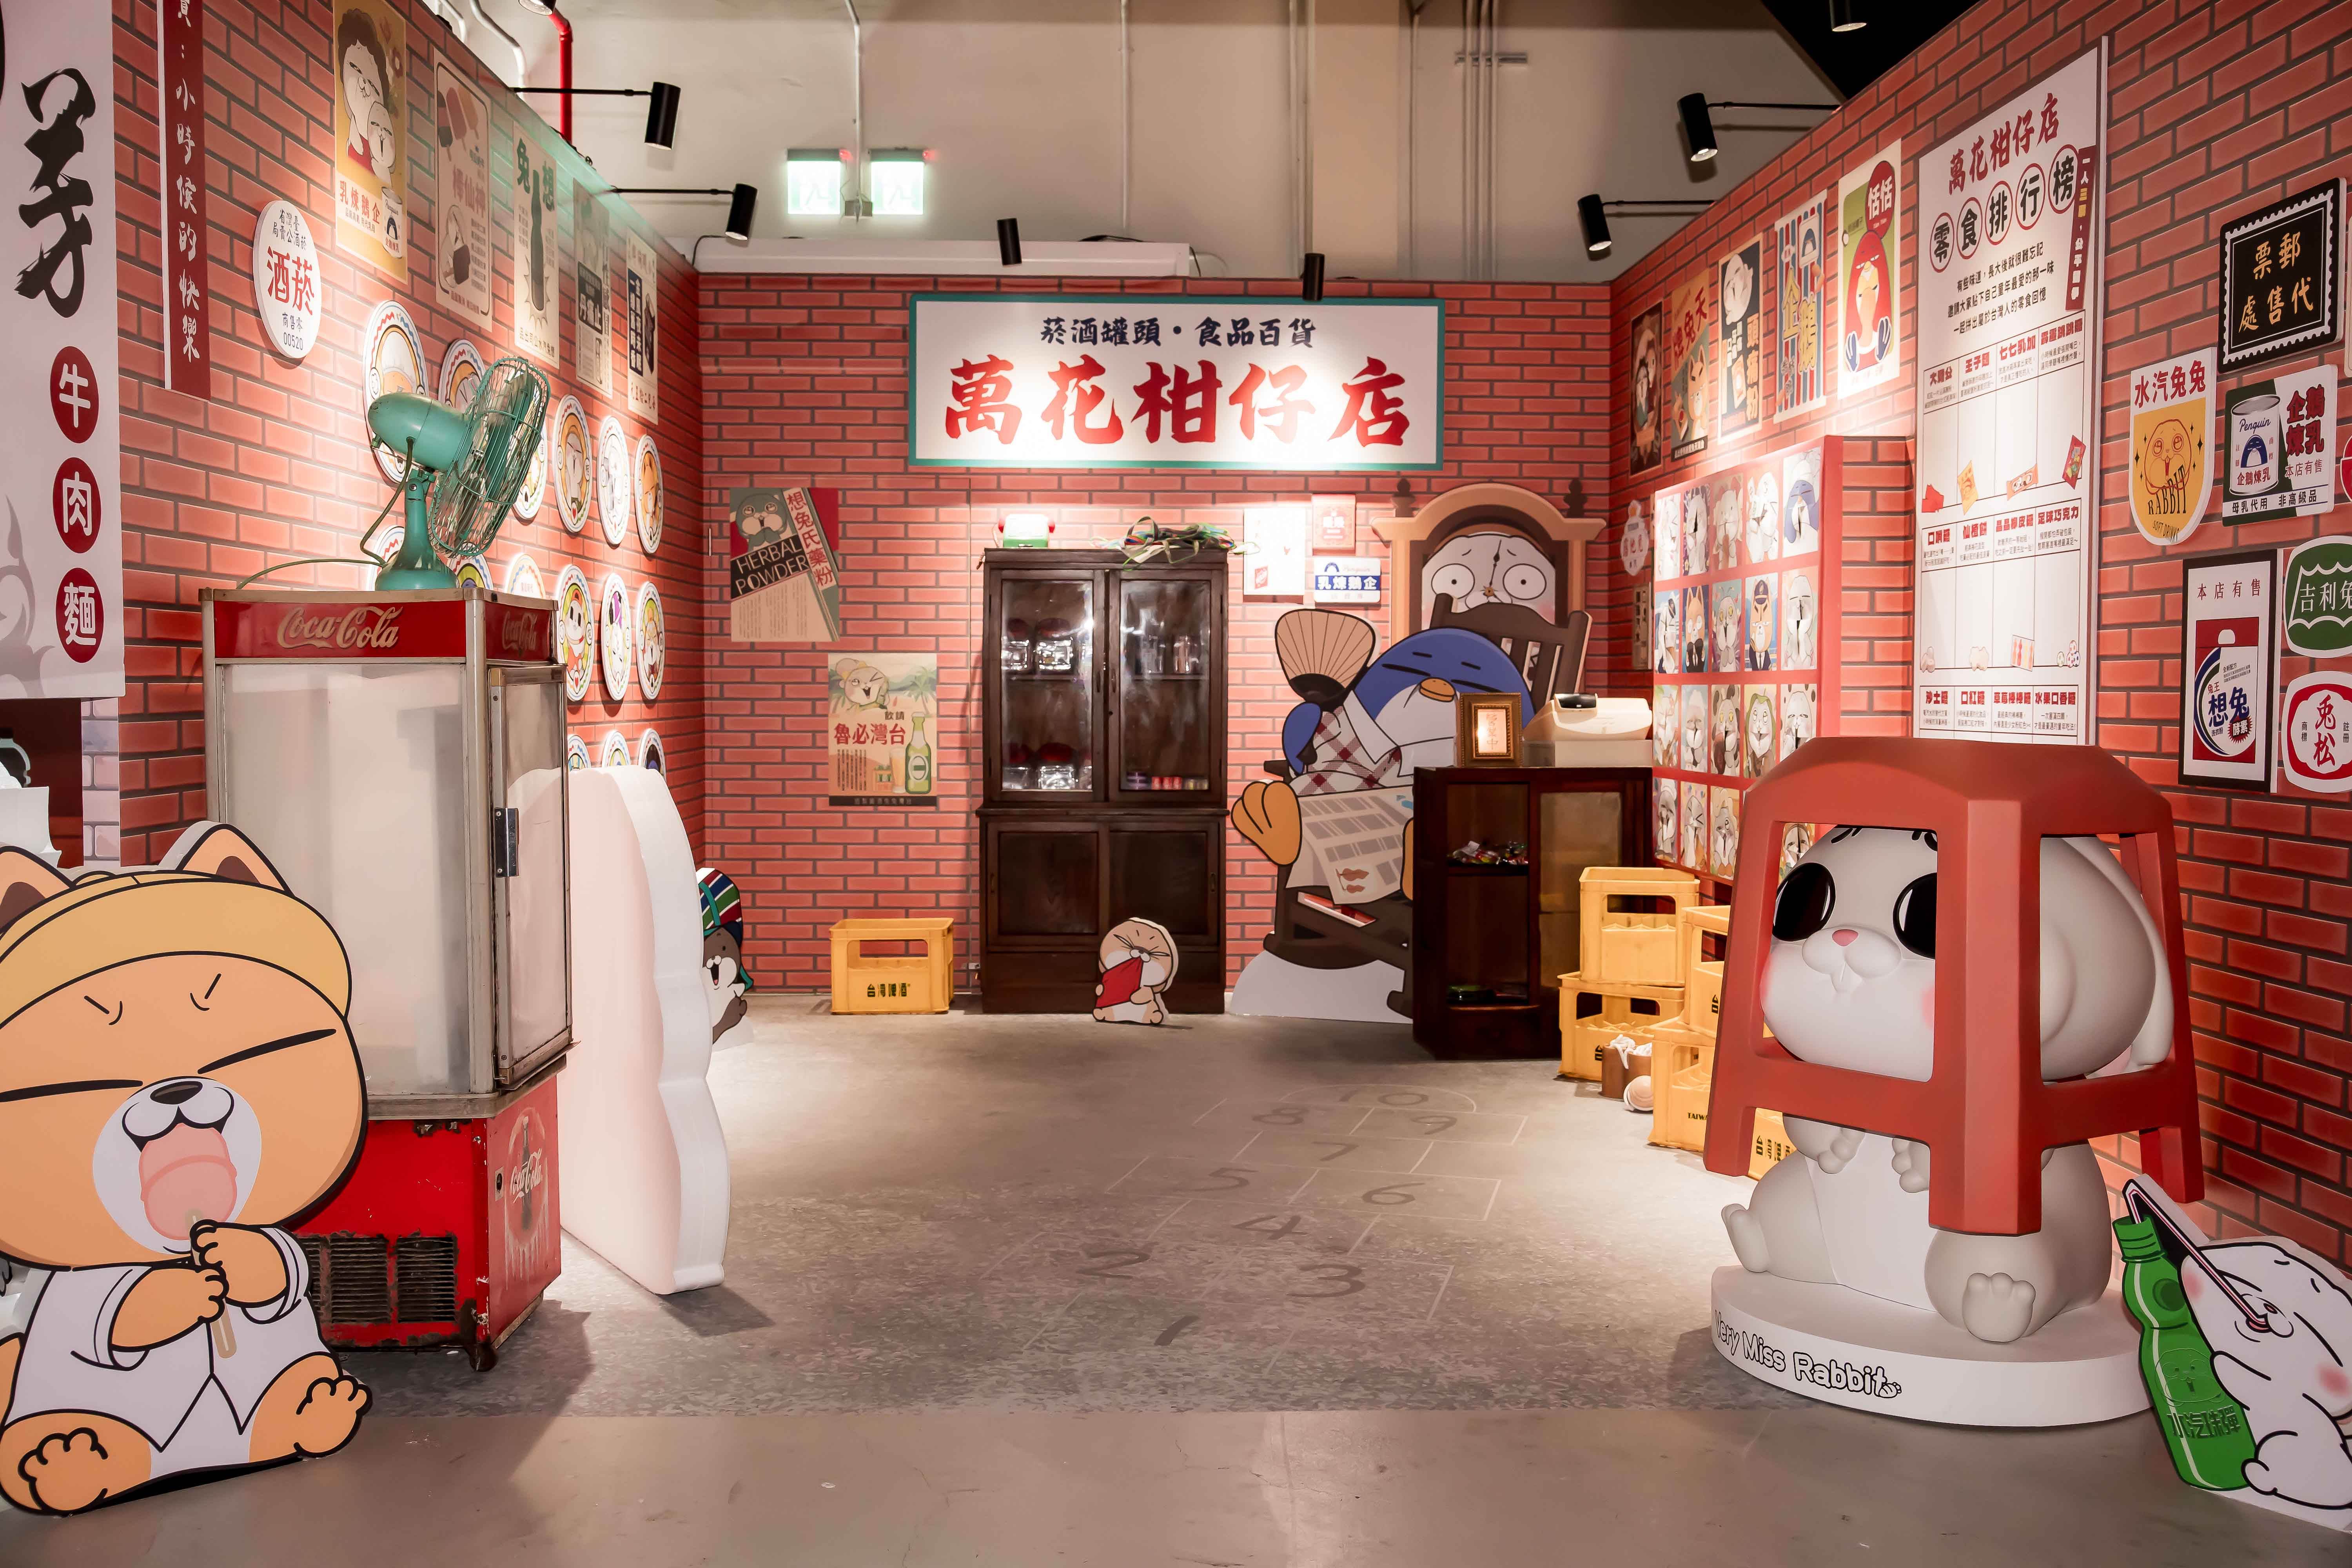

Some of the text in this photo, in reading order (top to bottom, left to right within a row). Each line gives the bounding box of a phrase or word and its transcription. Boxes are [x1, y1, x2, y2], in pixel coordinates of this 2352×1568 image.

[1948, 92, 2060, 196] 萬花柑仔店
[1867, 175, 1893, 221] 恬恬
[1933, 155, 2074, 263] 零食排行榜
[283, 332, 303, 350] 00520
[1999, 336, 2036, 361] 七七乳加
[945, 354, 1411, 448] 萬花柑仔店
[2287, 383, 2325, 424] 企鵝
[2239, 417, 2272, 435] Penguin
[2286, 419, 2325, 457] 煉乳
[2237, 466, 2271, 486] 企鵝煉乳
[2285, 459, 2323, 478] 本店有售
[2147, 464, 2187, 516] RABBIT
[2232, 489, 2317, 514] 母乳代用 非高級品
[59, 363, 96, 646] 牛肉麵
[2038, 506, 2080, 525] 足球巧克力
[787, 491, 833, 586] 想兔氏藥粉
[2152, 520, 2163, 532] SOFT
[736, 537, 803, 574] HERBAL
[735, 555, 809, 595] POWDER
[2197, 578, 2261, 601] 本店有售
[277, 606, 404, 649] Coca-Cola
[2035, 691, 2077, 706] 水果口香糖
[2208, 686, 2250, 728] 想兔
[2232, 720, 2249, 737] 酵素
[2301, 721, 2307, 742] 商標
[2313, 694, 2336, 768] 兔松
[2343, 720, 2350, 744] 註冊
[1338, 1089, 1429, 1106] 10
[1252, 1107, 1310, 1126] 8
[1412, 1115, 1458, 1135] 9
[1311, 1141, 1360, 1161] 7
[1176, 1167, 1258, 1192] 5
[1362, 1182, 1426, 1205] 6
[1234, 1214, 1310, 1240] 4
[1076, 1249, 1151, 1280] 2
[1285, 1264, 1367, 1298] 3
[1154, 1316, 1200, 1345] 1
[1715, 1309, 1889, 1397] Very Miss Rabbit
